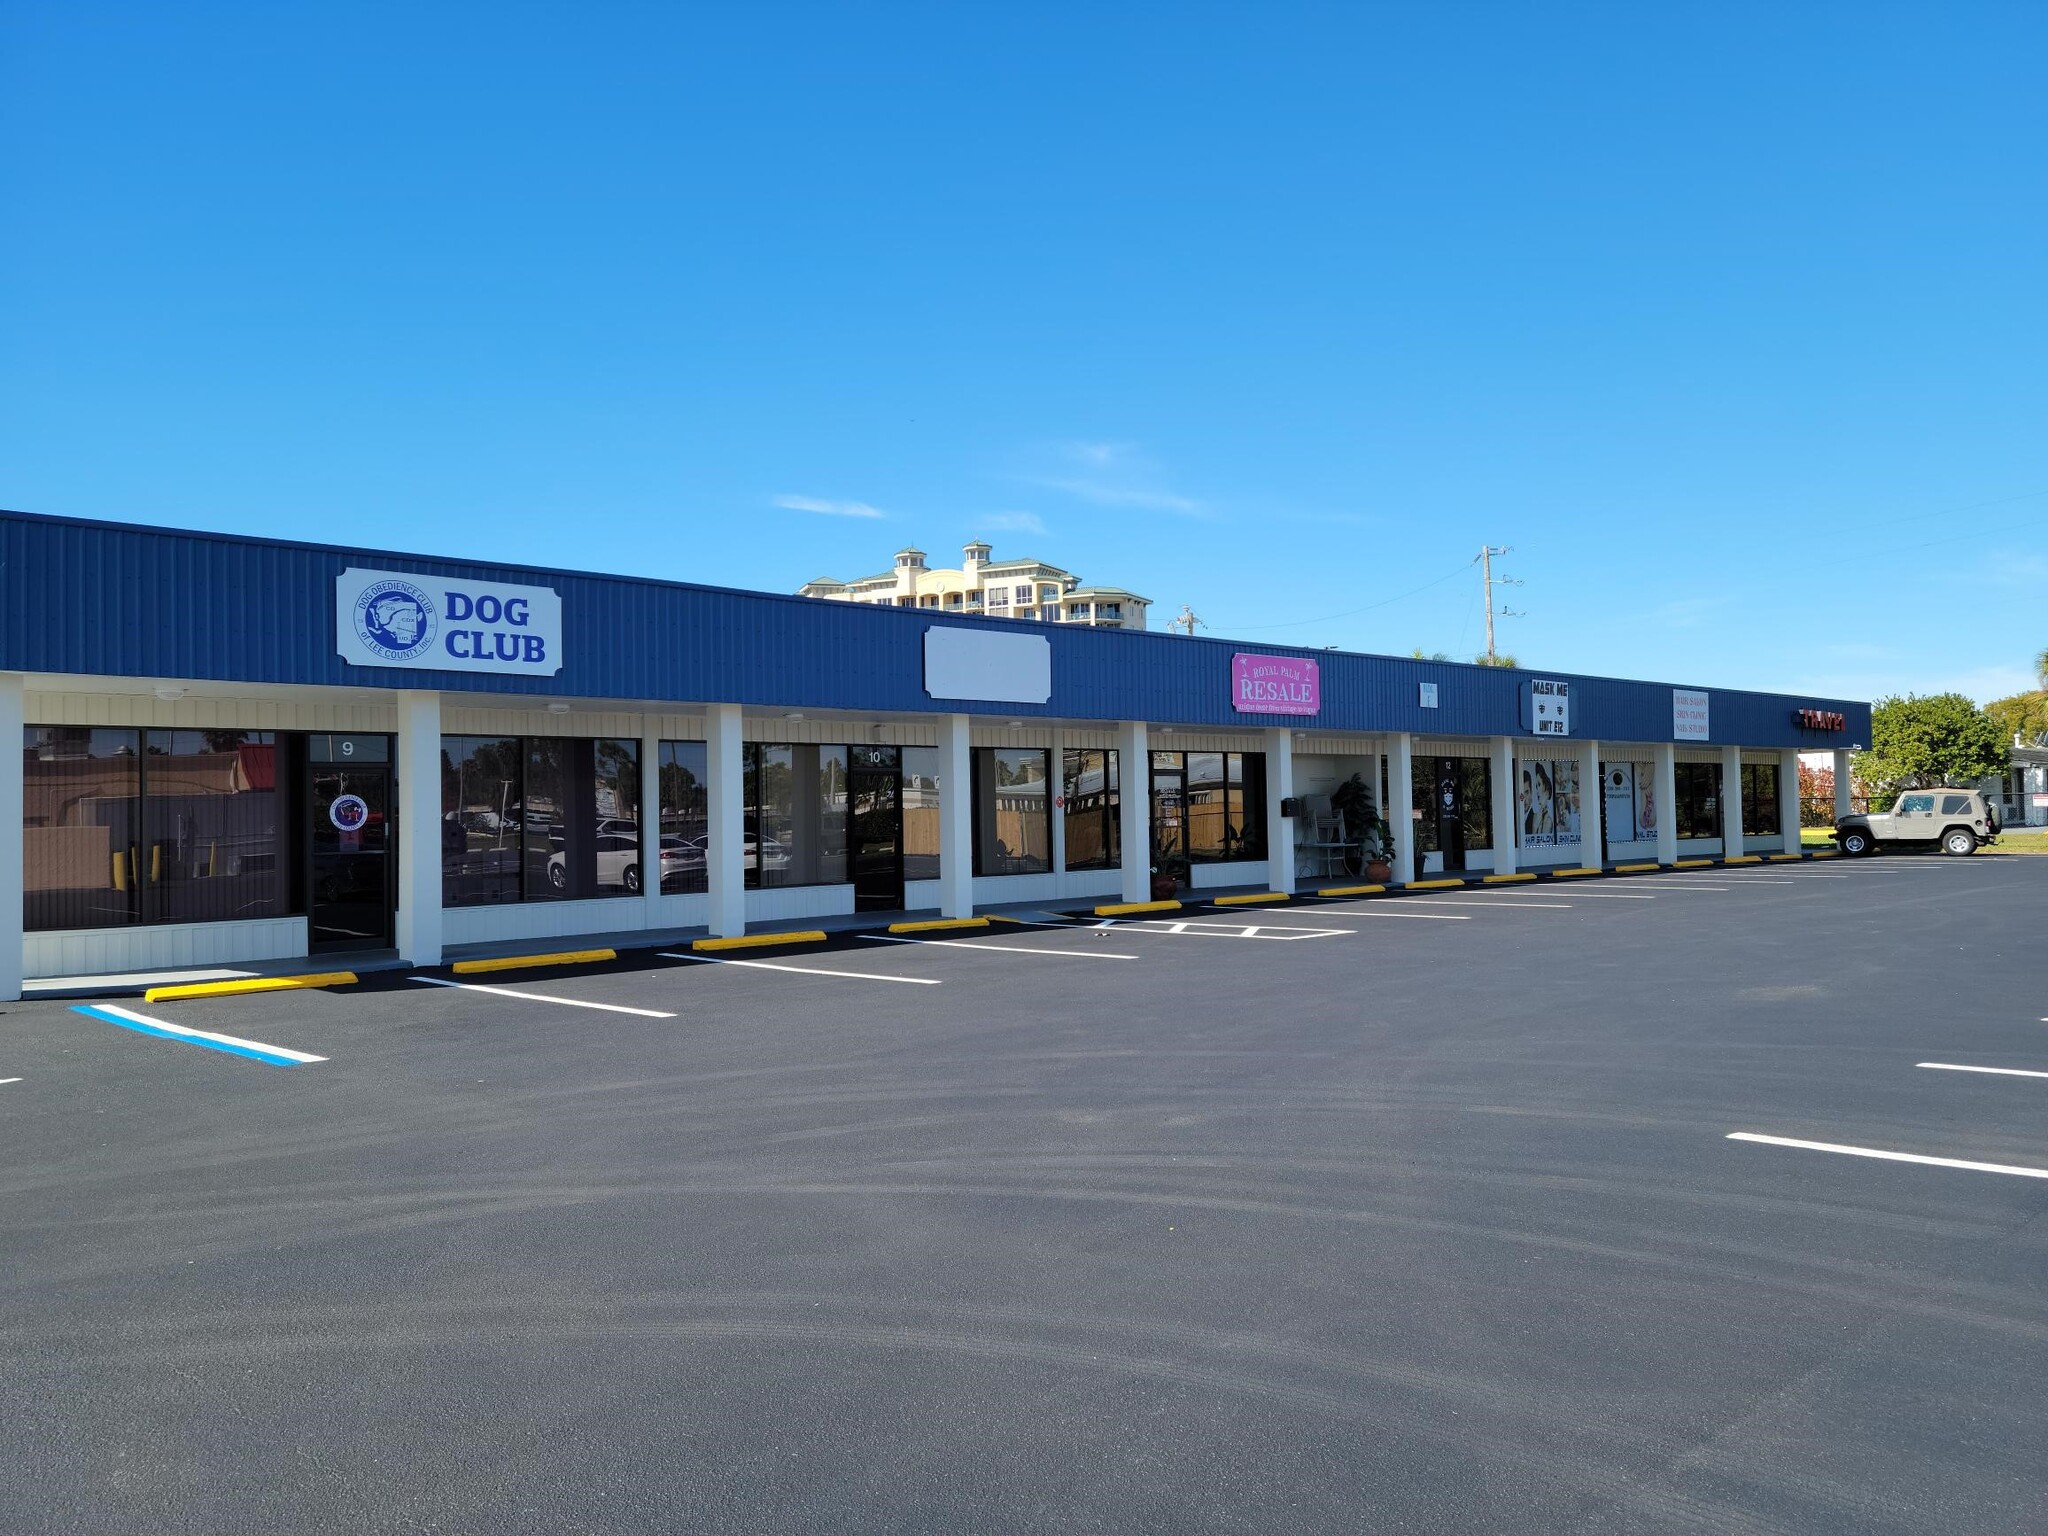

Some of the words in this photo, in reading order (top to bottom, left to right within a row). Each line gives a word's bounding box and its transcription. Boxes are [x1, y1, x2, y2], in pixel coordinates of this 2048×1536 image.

[358, 592, 373, 610] DOG
[371, 582, 418, 597] OBEDIENCE
[416, 593, 433, 614] CLUB
[444, 591, 530, 626] DOG
[368, 640, 385, 654] LEE
[445, 629, 546, 663] CLUB
[1253, 666, 1279, 679] ROYAL
[1280, 666, 1300, 681] PALM
[1240, 678, 1313, 703] RESALE
[1533, 681, 1555, 695] MASK
[1557, 683, 1568, 696] ME
[1675, 696, 1688, 705] HAIR
[1689, 696, 1707, 707] SALON
[1676, 710, 1689, 719] SKIN
[1690, 711, 1706, 720] CLINIC
[1539, 720, 1553, 732] UNIT
[1554, 721, 1564, 733] E12
[1689, 724, 1708, 734] STUDIO
[342, 741, 354, 756] 9
[869, 751, 880, 763] 10
[1445, 761, 1451, 770] 12
[1536, 835, 1553, 844] SALON
